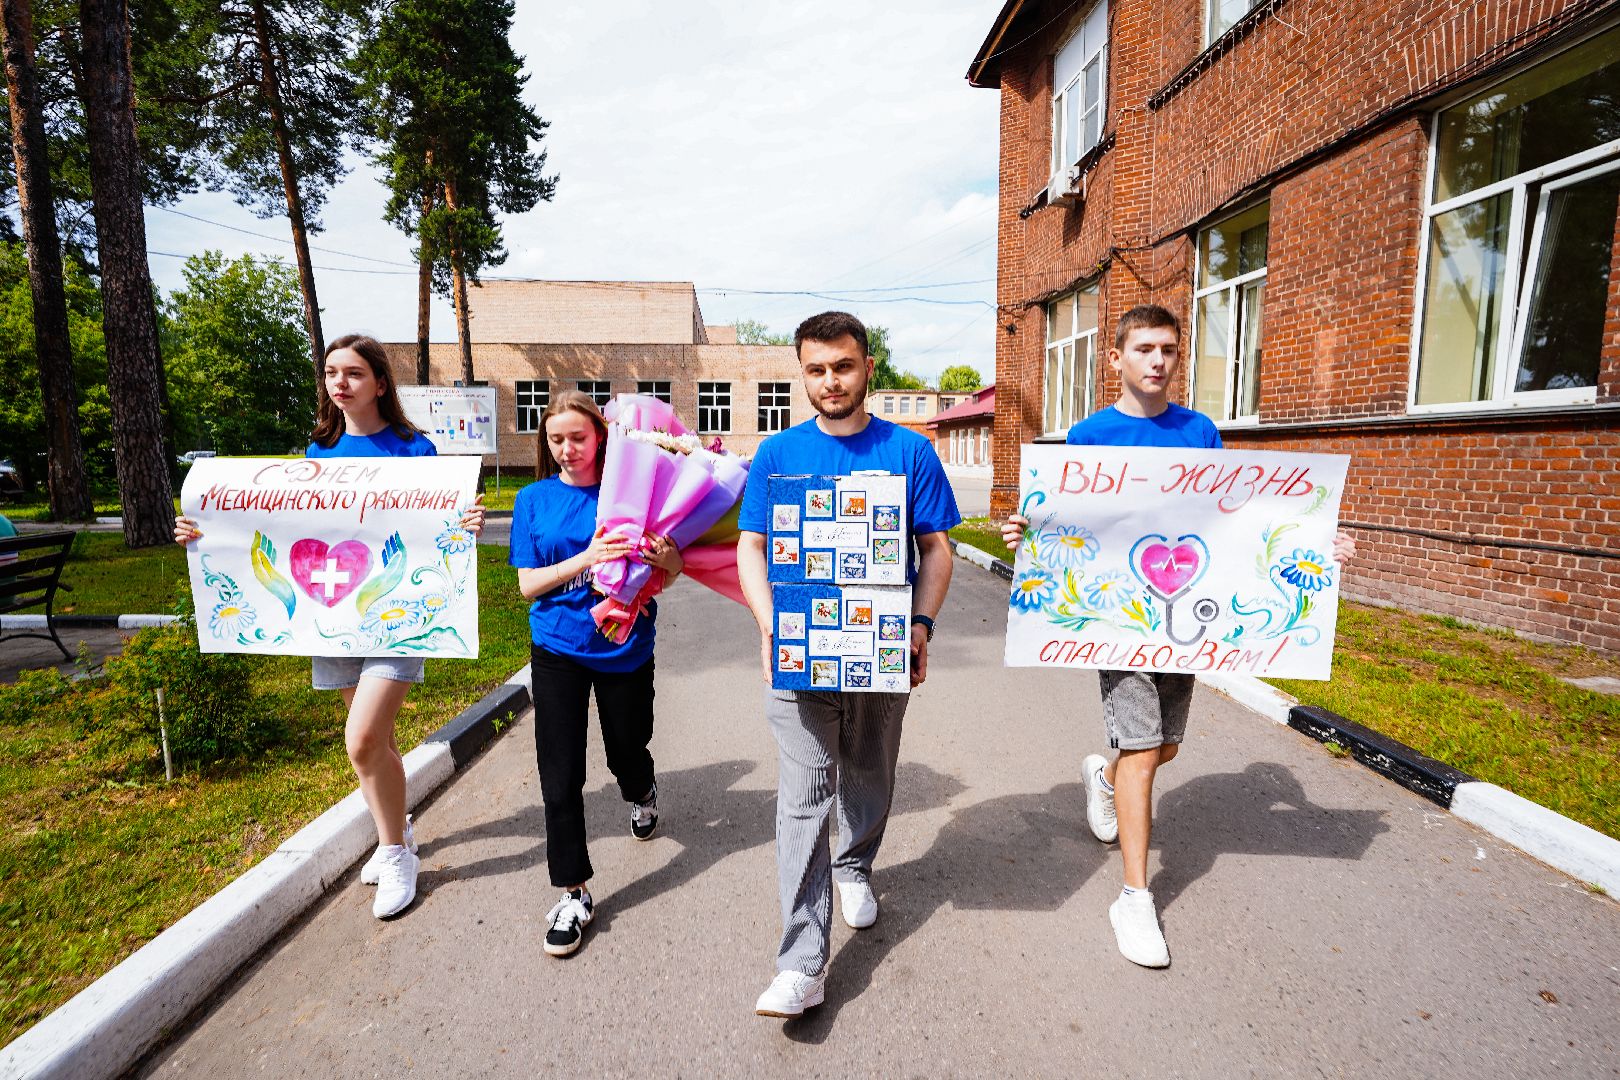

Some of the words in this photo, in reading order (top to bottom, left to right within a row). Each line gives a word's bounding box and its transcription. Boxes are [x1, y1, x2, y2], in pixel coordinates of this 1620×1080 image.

[252, 461, 286, 485] С
[201, 483, 355, 513] МЕДИЦИНСКОГО
[1161, 464, 1314, 513] ЖИЗНЬ
[1039, 640, 1173, 669] СПАСИБО
